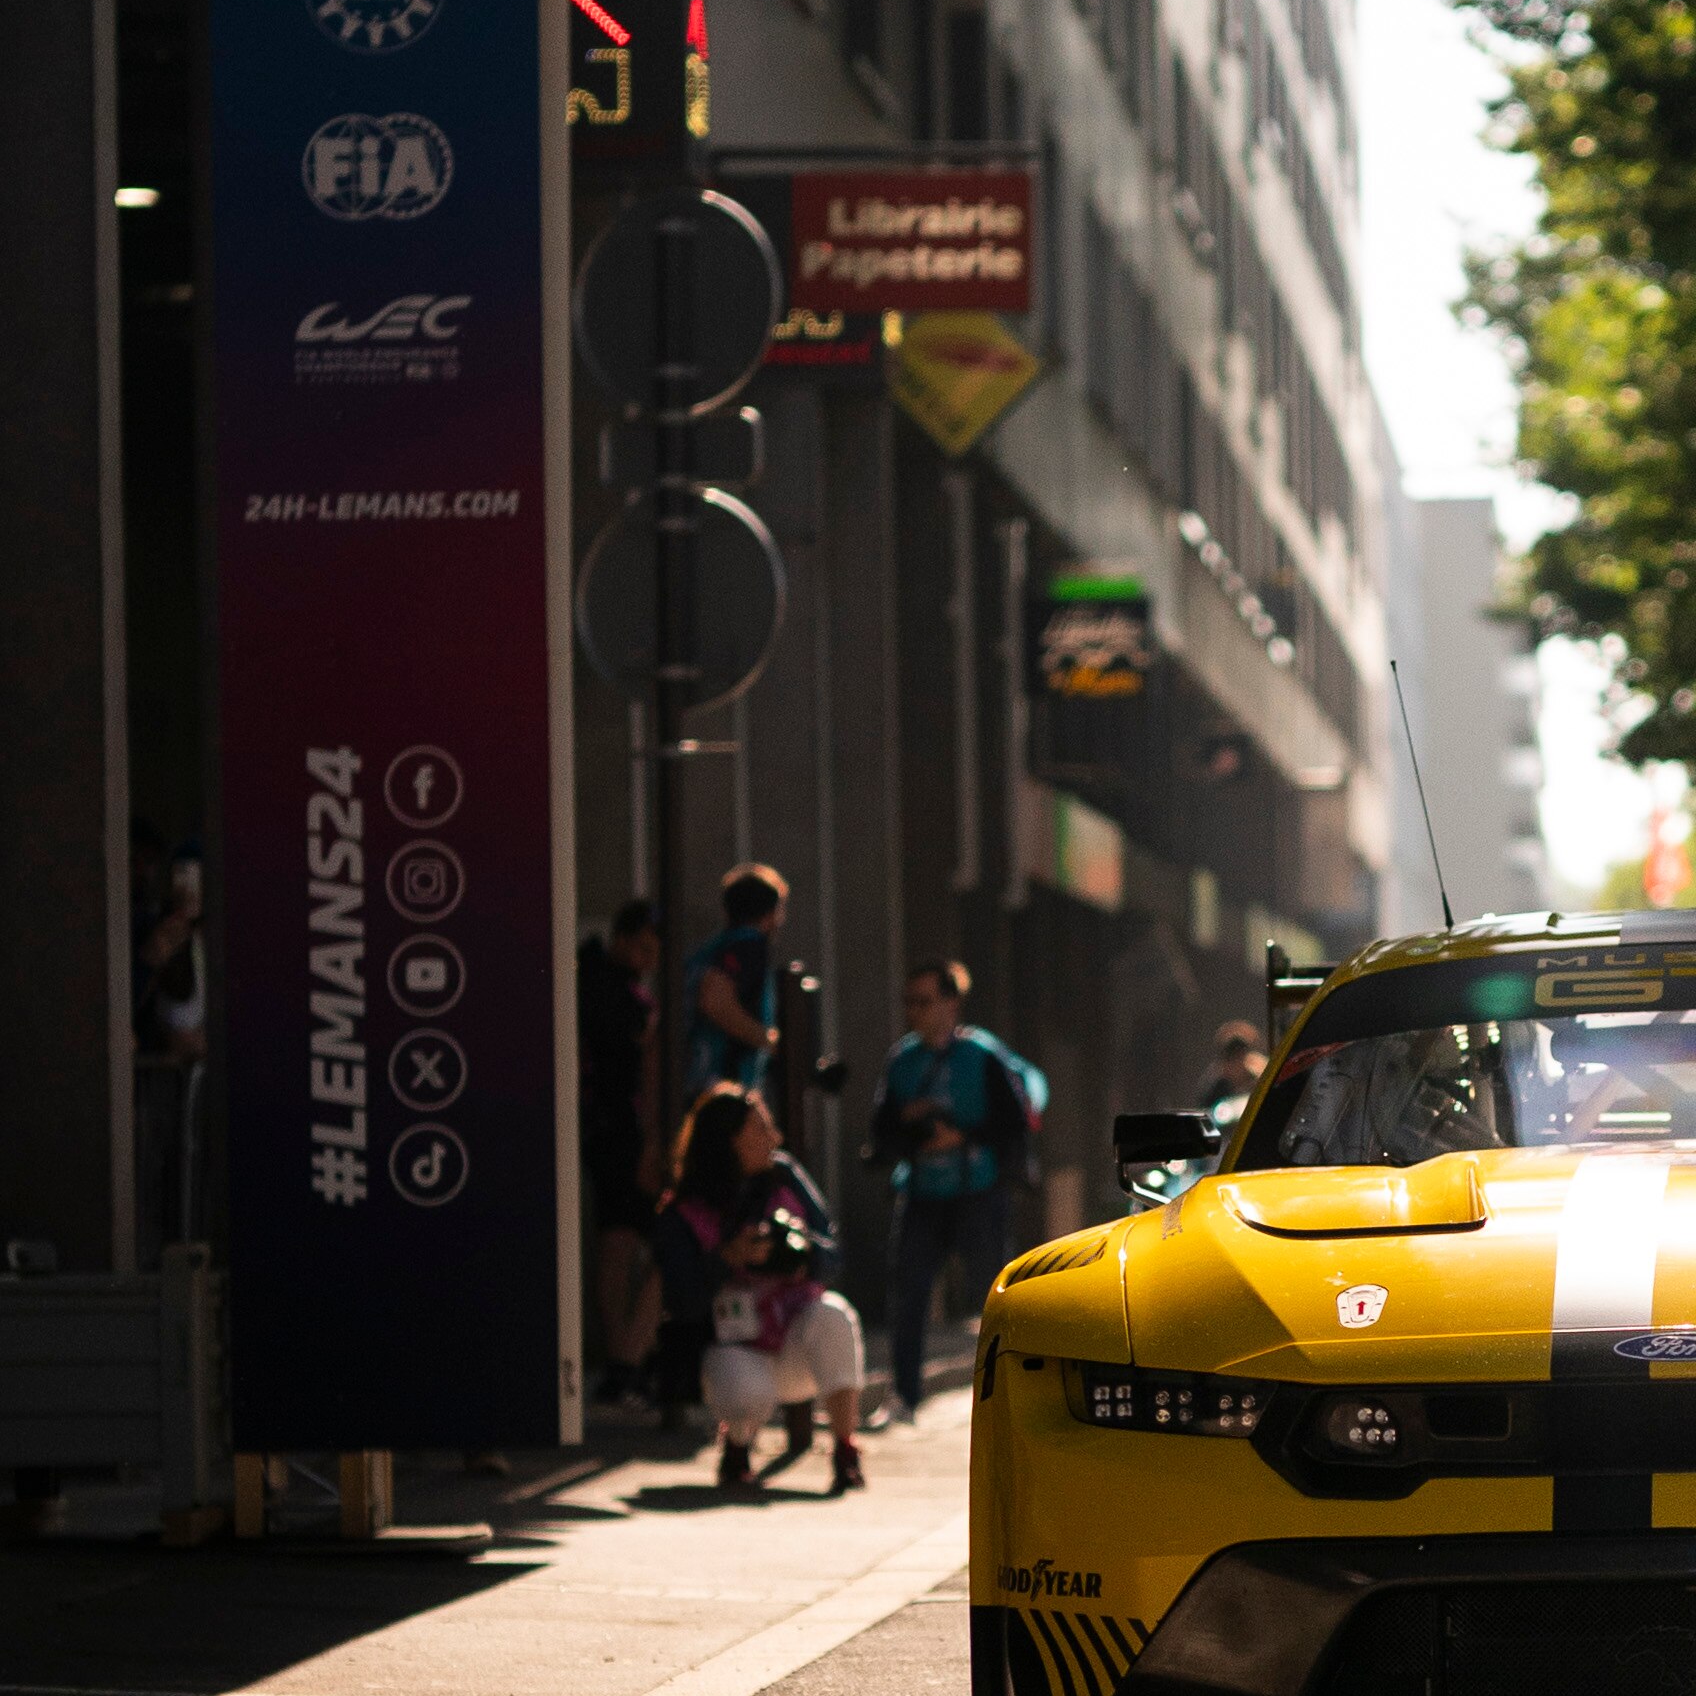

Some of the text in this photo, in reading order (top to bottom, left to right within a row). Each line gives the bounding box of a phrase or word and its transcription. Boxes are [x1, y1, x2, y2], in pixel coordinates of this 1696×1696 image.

[312, 134, 438, 197] FIA
[294, 293, 473, 342] WEC
[244, 489, 521, 522] 24H-LEMANS.COM
[304, 743, 369, 1207] #LEMANS24
